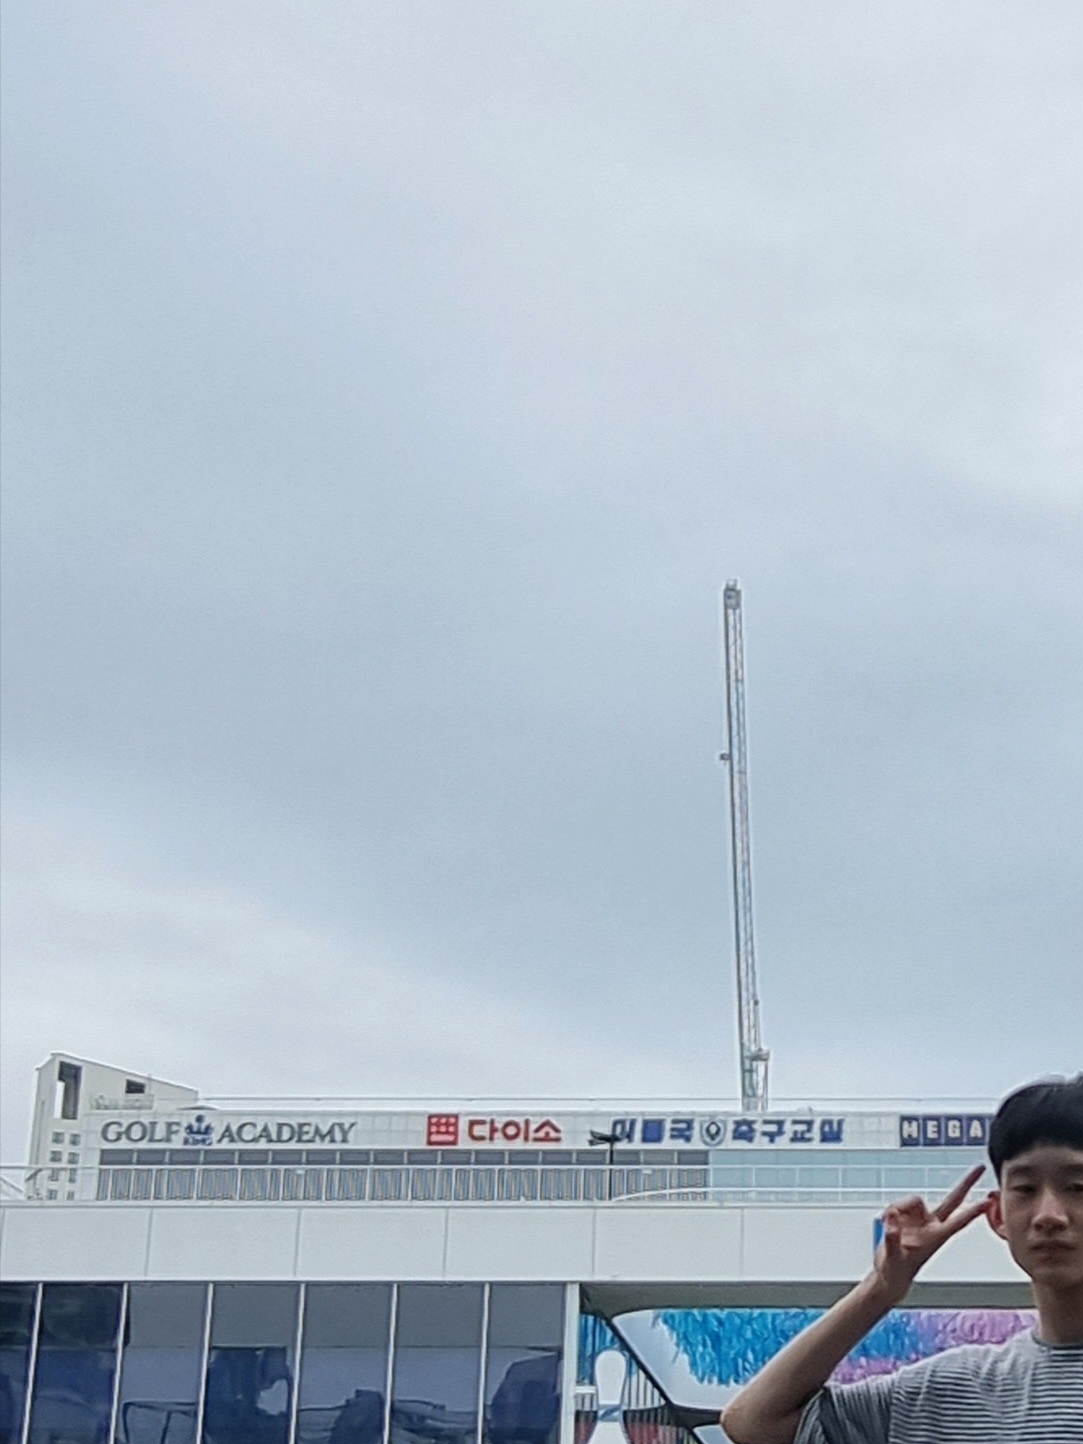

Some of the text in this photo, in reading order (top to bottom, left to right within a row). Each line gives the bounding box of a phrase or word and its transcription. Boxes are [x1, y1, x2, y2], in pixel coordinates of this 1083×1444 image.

[101, 1121, 357, 1144] GOLF ACADEMY
[467, 1118, 562, 1142] 다이소
